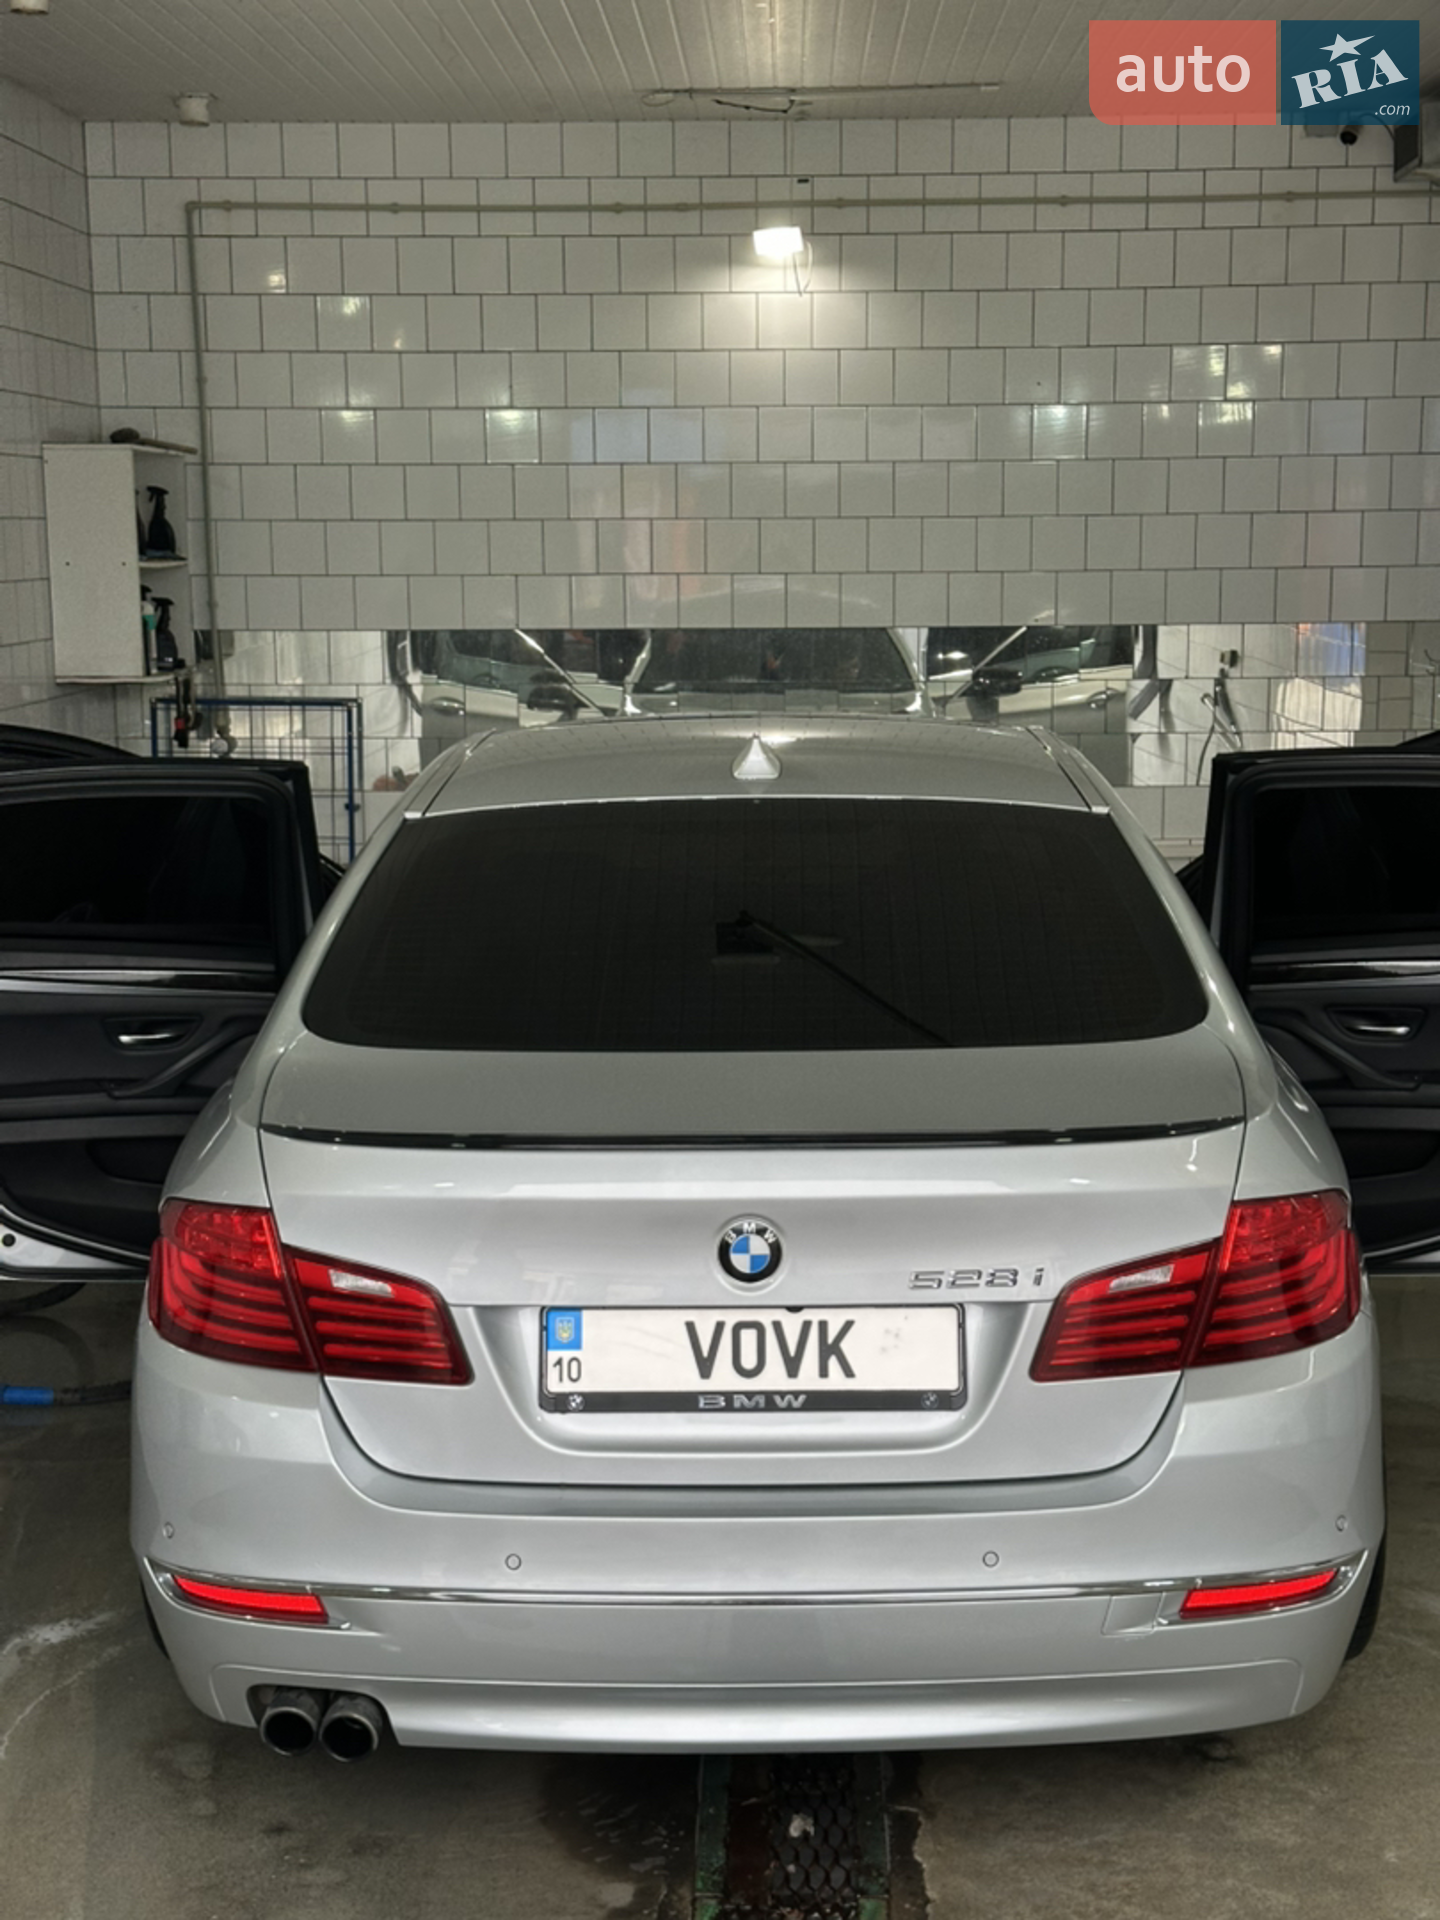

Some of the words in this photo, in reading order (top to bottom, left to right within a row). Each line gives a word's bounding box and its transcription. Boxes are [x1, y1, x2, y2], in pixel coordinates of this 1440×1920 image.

[725, 1222, 777, 1244] BMW
[685, 1319, 857, 1380] VOVK
[552, 1356, 582, 1383] 10
[698, 1395, 807, 1409] BMW
